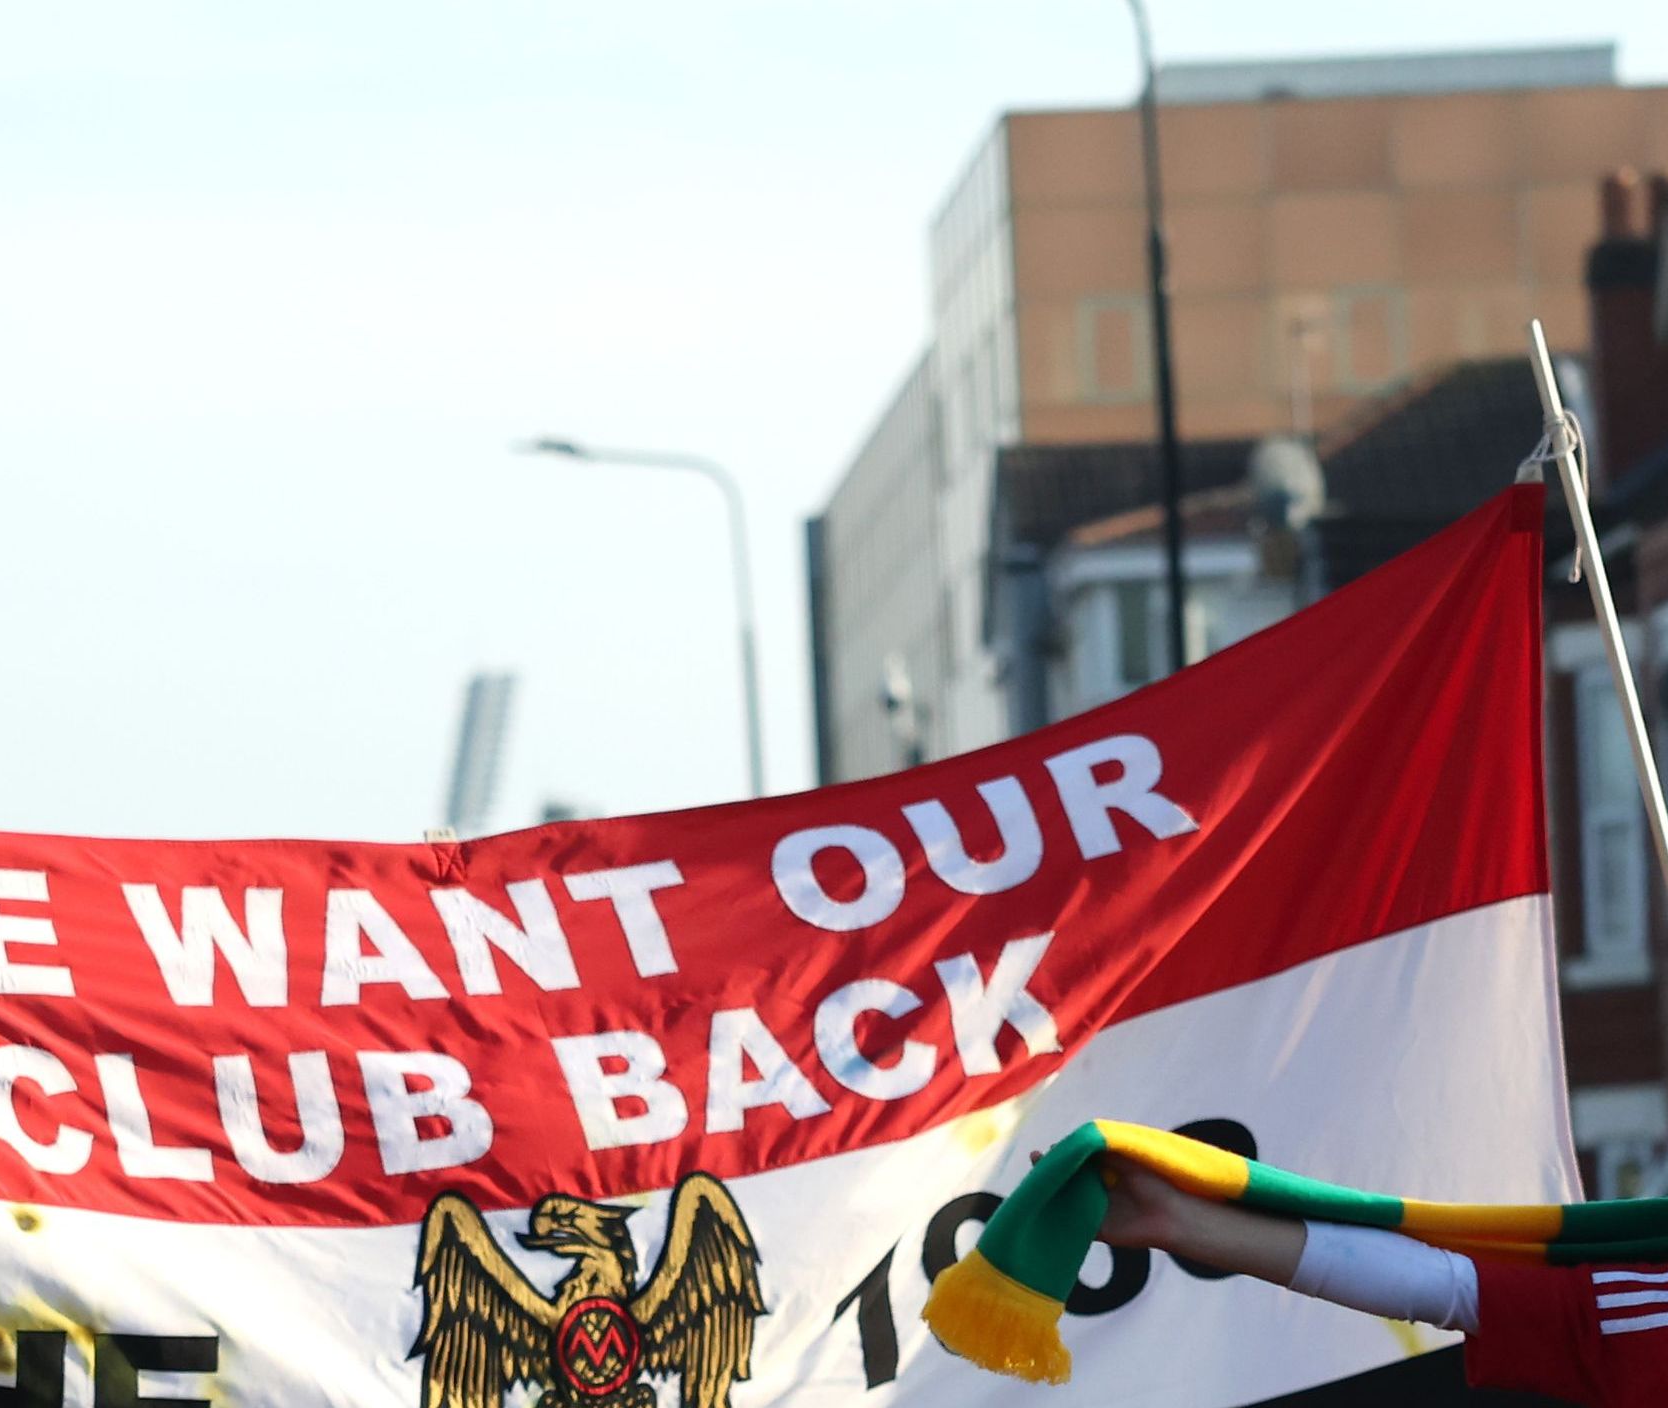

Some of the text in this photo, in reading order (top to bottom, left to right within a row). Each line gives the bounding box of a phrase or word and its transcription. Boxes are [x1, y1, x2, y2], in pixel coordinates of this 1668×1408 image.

[122, 858, 685, 1007] WANT
[771, 733, 1200, 932] OUR
[551, 930, 1064, 1151] BACK
